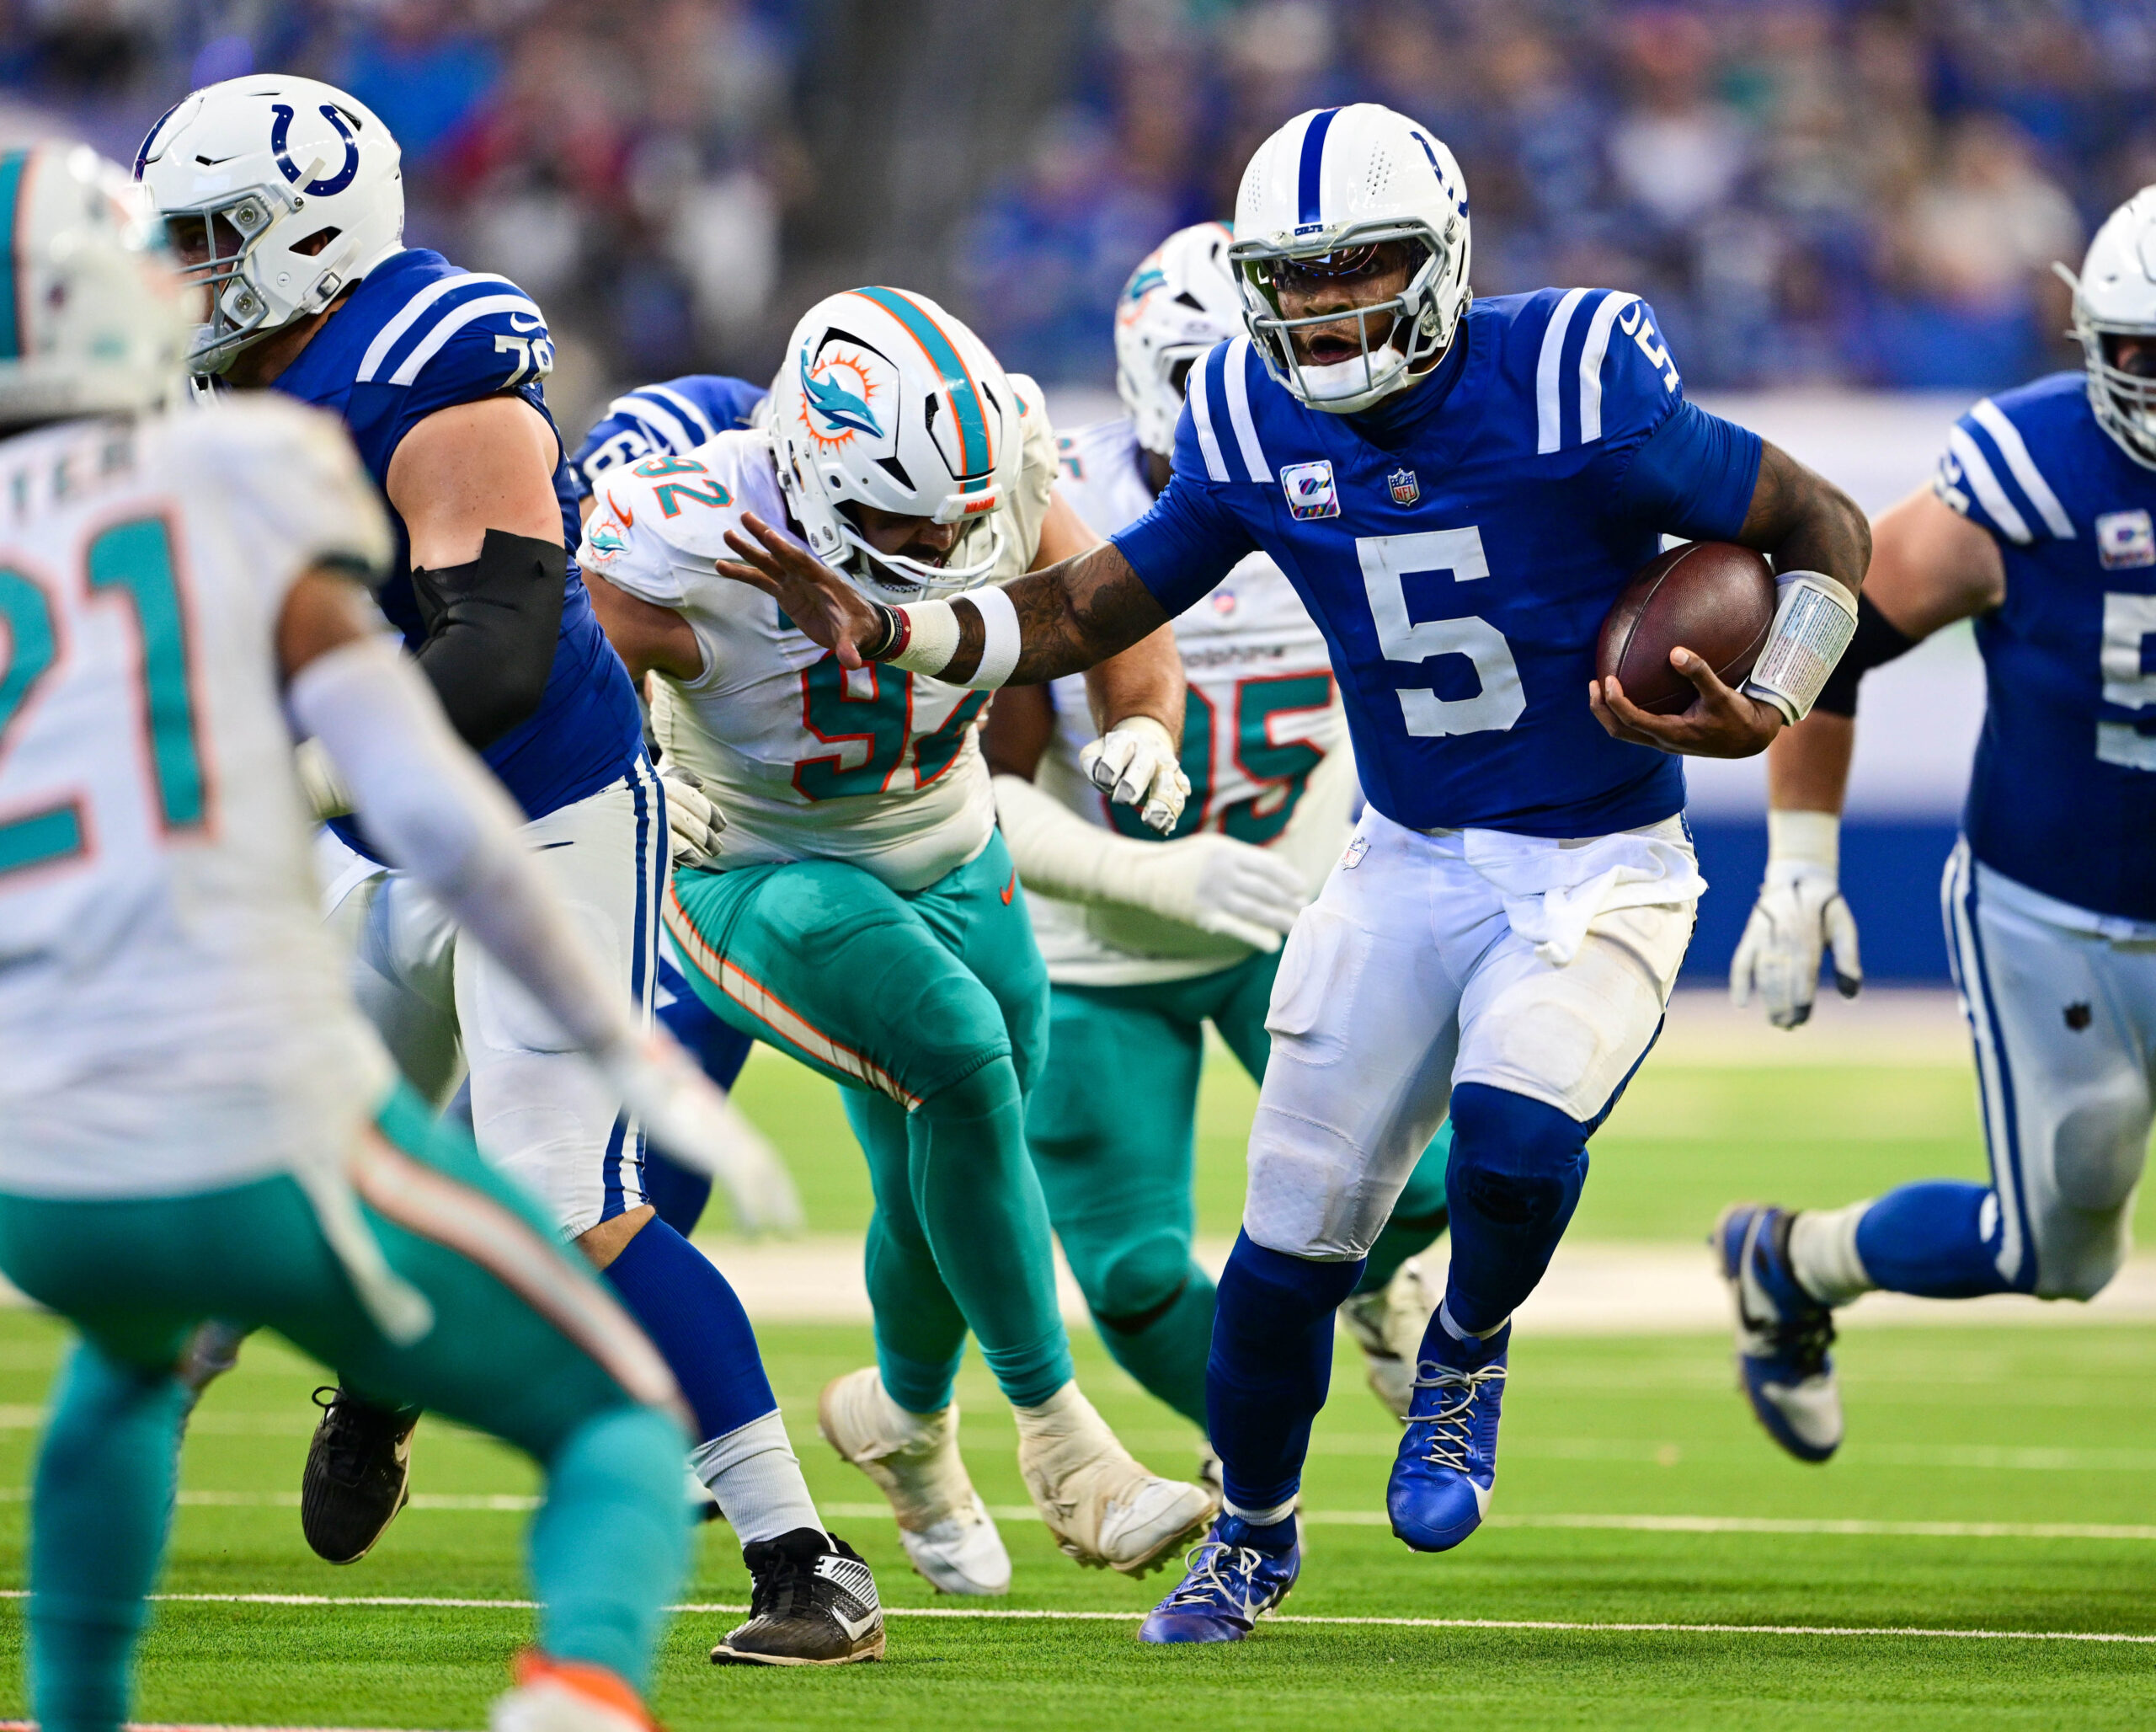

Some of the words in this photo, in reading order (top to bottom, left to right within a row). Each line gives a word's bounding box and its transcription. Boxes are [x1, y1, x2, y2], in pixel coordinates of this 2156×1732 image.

[1294, 224, 1324, 237] COLTS
[1634, 318, 1679, 394] 5
[632, 455, 734, 520] 92
[1286, 466, 1333, 506] C
[1395, 485, 1416, 501] NFL
[1354, 526, 1526, 737] 5
